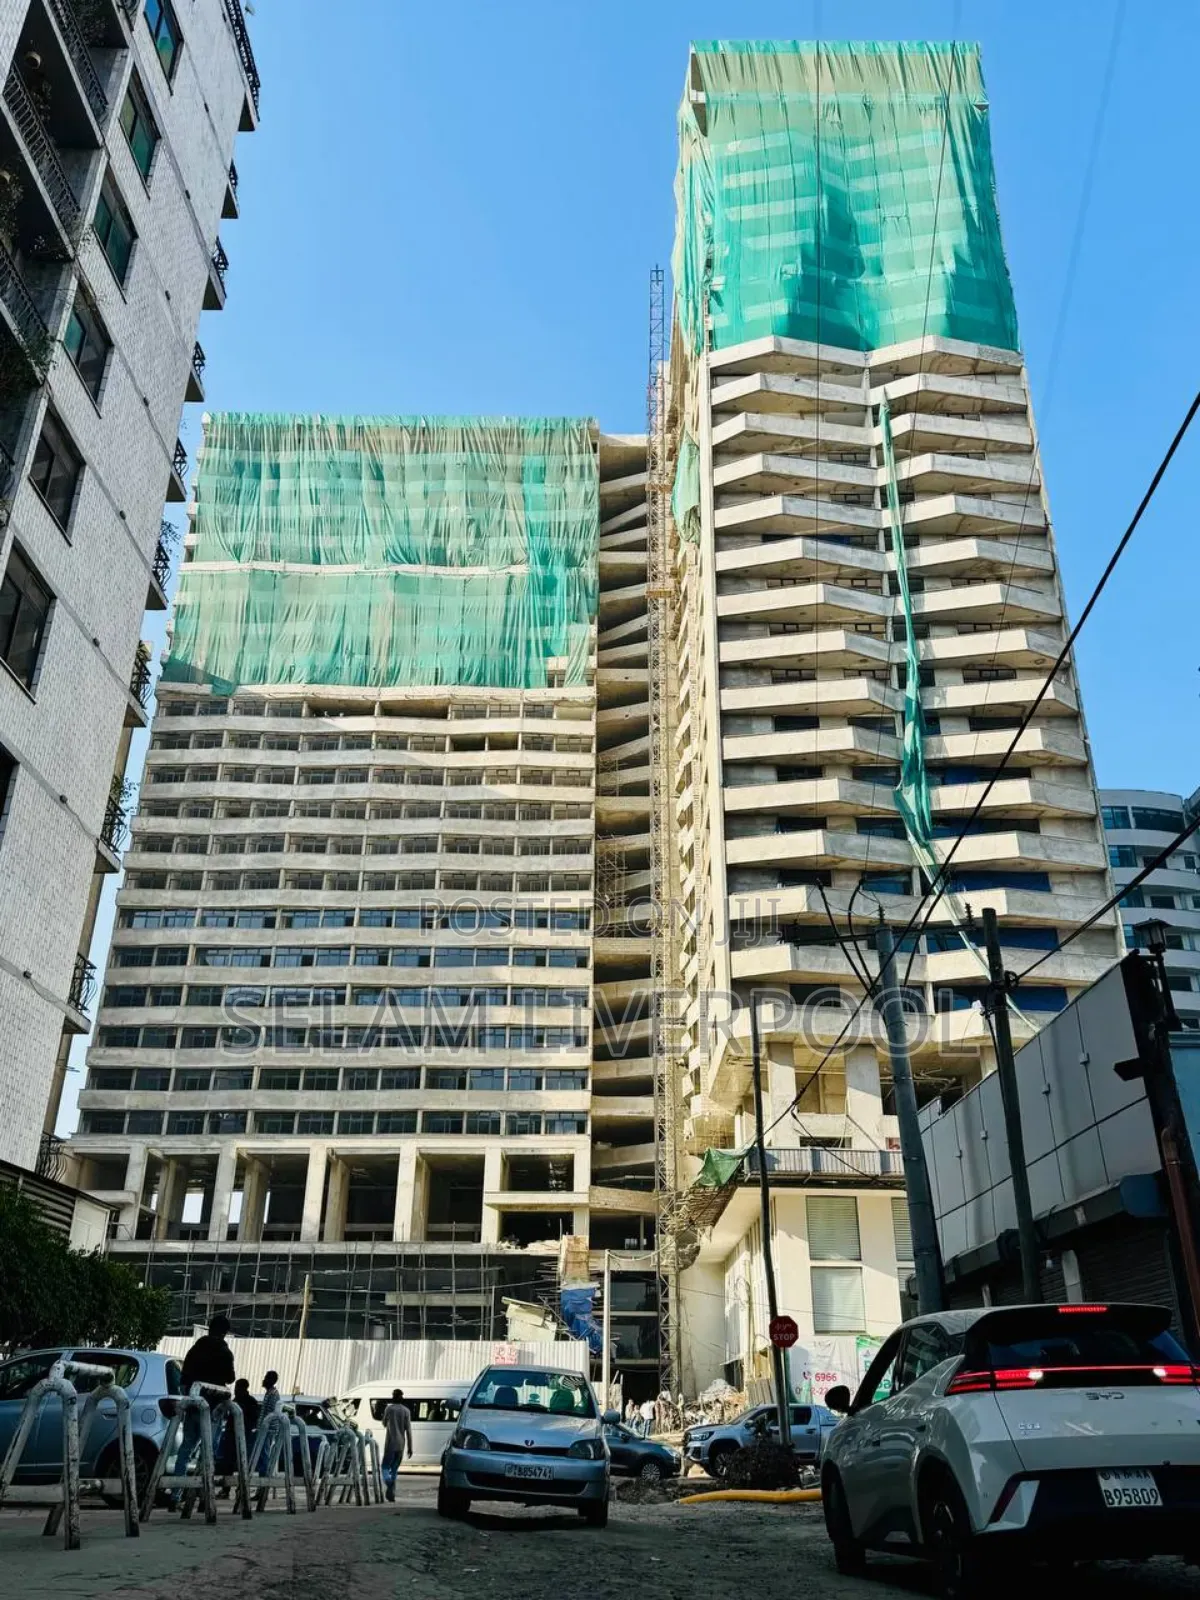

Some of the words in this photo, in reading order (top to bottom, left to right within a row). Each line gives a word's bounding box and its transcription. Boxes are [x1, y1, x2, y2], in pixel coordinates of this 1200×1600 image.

[773, 1333, 795, 1341] STOP
[815, 1373, 837, 1382] 6966
[1103, 1488, 1158, 1505] B95809
